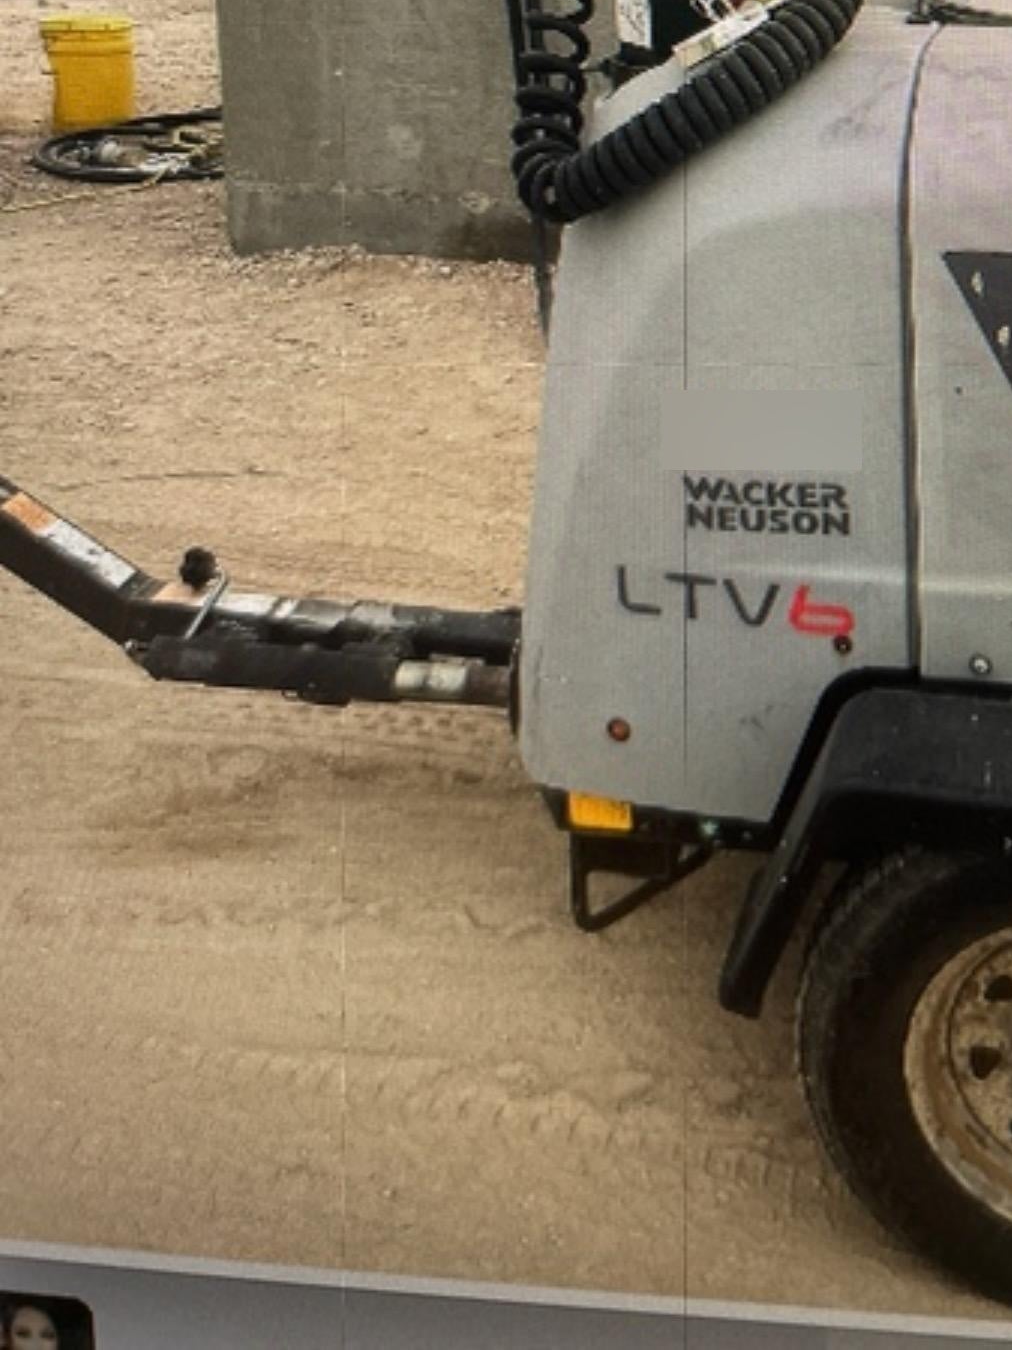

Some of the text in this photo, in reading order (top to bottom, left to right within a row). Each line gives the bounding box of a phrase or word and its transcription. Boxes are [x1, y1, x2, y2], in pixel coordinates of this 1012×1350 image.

[683, 475, 848, 508] WACKER
[686, 504, 850, 536] NEUSON
[616, 564, 855, 638] LTV6
